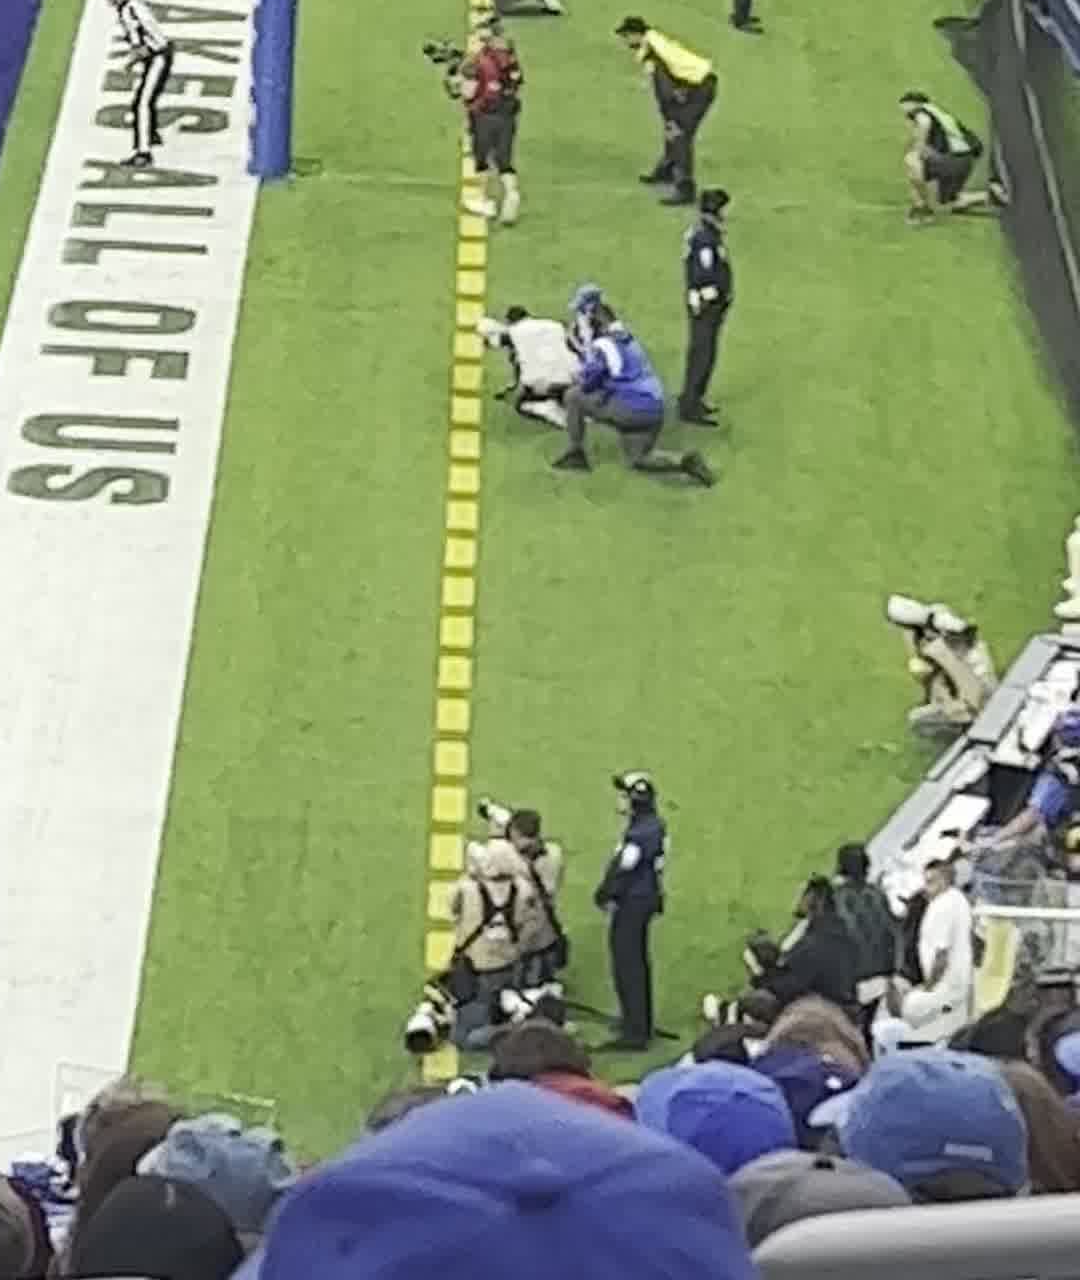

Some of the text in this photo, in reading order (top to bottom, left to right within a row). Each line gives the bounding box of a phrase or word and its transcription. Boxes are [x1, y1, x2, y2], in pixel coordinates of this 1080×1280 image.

[61, 159, 219, 266] ALL
[39, 297, 198, 381] OF
[6, 412, 181, 507] US
